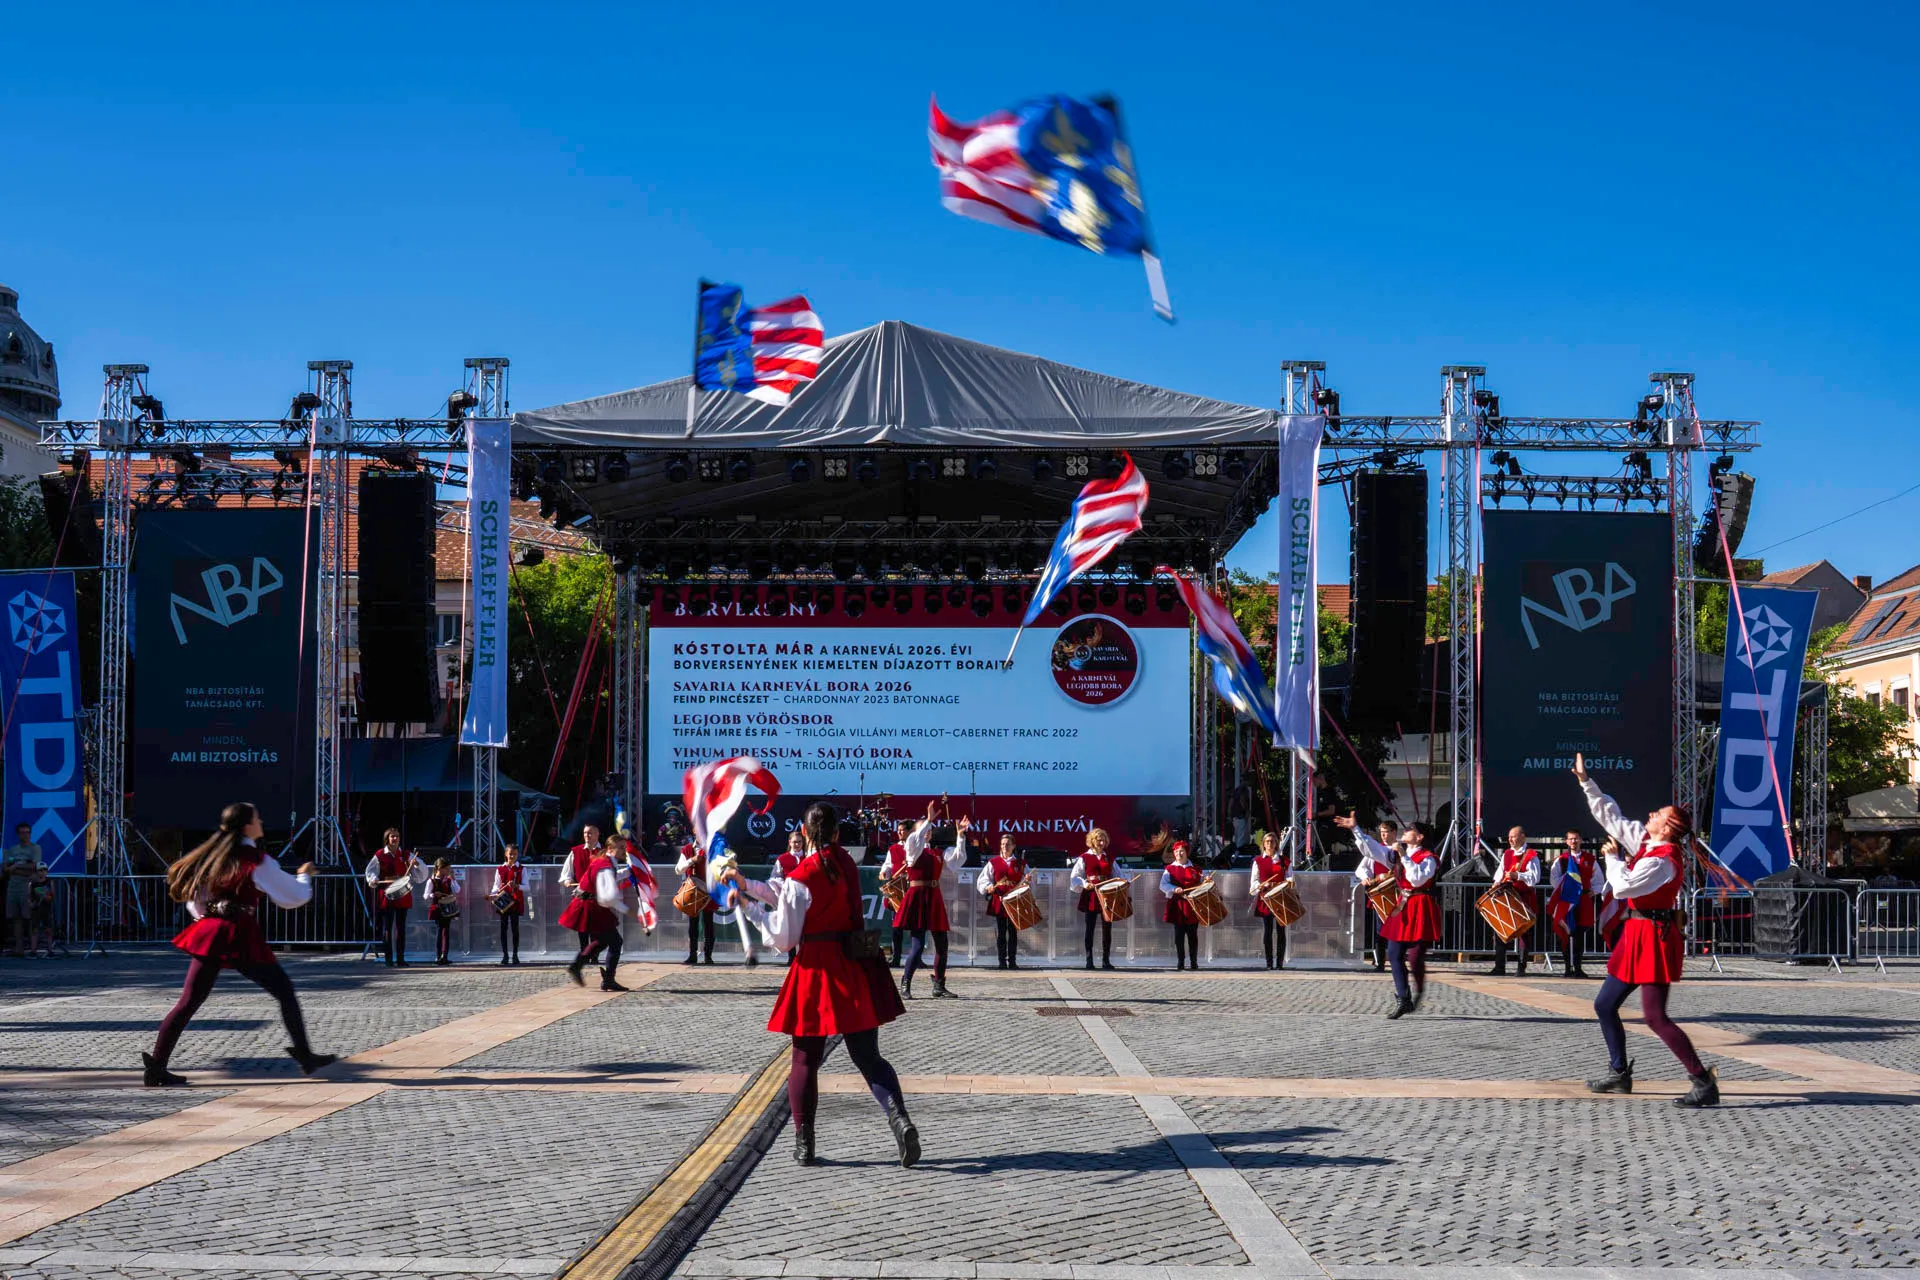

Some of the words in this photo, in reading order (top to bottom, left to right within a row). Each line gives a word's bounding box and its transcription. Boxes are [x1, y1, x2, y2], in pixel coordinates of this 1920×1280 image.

[479, 500, 498, 667] SCHAEFFLER
[1290, 498, 1310, 666] SCHAEFFLER
[170, 557, 283, 645] NBA
[1520, 562, 1636, 650] NBA
[674, 641, 768, 655] KÓSTOLTA
[776, 641, 814, 655] MÁR
[820, 645, 828, 655] A
[833, 643, 903, 655] KARNEVÁL
[908, 645, 945, 655] 2026.
[951, 643, 972, 655] ÉVI
[674, 658, 798, 670] BORVERSENYÉNEK
[803, 660, 878, 670] KIEMELTEN
[884, 658, 951, 670] DÍJAZOTT
[956, 660, 1014, 670] BORAIT?
[186, 687, 204, 695] NBA
[673, 681, 736, 692] SAVARIA
[741, 680, 822, 692] KARNEVÁL
[827, 681, 869, 692] BORA
[875, 681, 912, 692] 2026
[674, 695, 706, 704] FEIND
[709, 694, 769, 704] PINCÉSZET
[784, 695, 860, 704] CHARDONNAY
[864, 695, 889, 704] 2023
[893, 695, 960, 704] BATONNAGE
[1539, 692, 1558, 701] NBA
[674, 714, 741, 727] LEGJOBB
[746, 713, 834, 725] VÖRÖSBOR
[673, 727, 711, 737] TIFFÁN
[714, 728, 742, 737] IMRE
[745, 727, 758, 737] ÉS
[761, 728, 778, 737] FIA
[795, 727, 846, 737] TRILÓGIA
[849, 727, 897, 737] VILLÁNYI
[1013, 728, 1048, 737] FRANC
[1052, 728, 1078, 737] 2022
[17, 650, 76, 855] TDK
[171, 752, 196, 762] AMI
[200, 749, 278, 762] BIZTOSÍTÁS
[673, 747, 725, 758] VINUM
[731, 747, 802, 758] PRESSUM
[817, 745, 865, 760] SAJTÓ
[870, 748, 913, 758] BORA
[761, 761, 778, 770] FIA
[795, 760, 846, 770] TRILÓGIA
[849, 760, 897, 770] VILLÁNYI
[1013, 761, 1048, 770] FRANC
[1052, 761, 1078, 770] 2022
[1523, 758, 1550, 769] AMI
[1554, 756, 1634, 769] BIZOSÍTÁS
[1719, 669, 1787, 875] TDK
[752, 820, 771, 828] XXV
[998, 814, 1095, 833] KARNEVÁL
